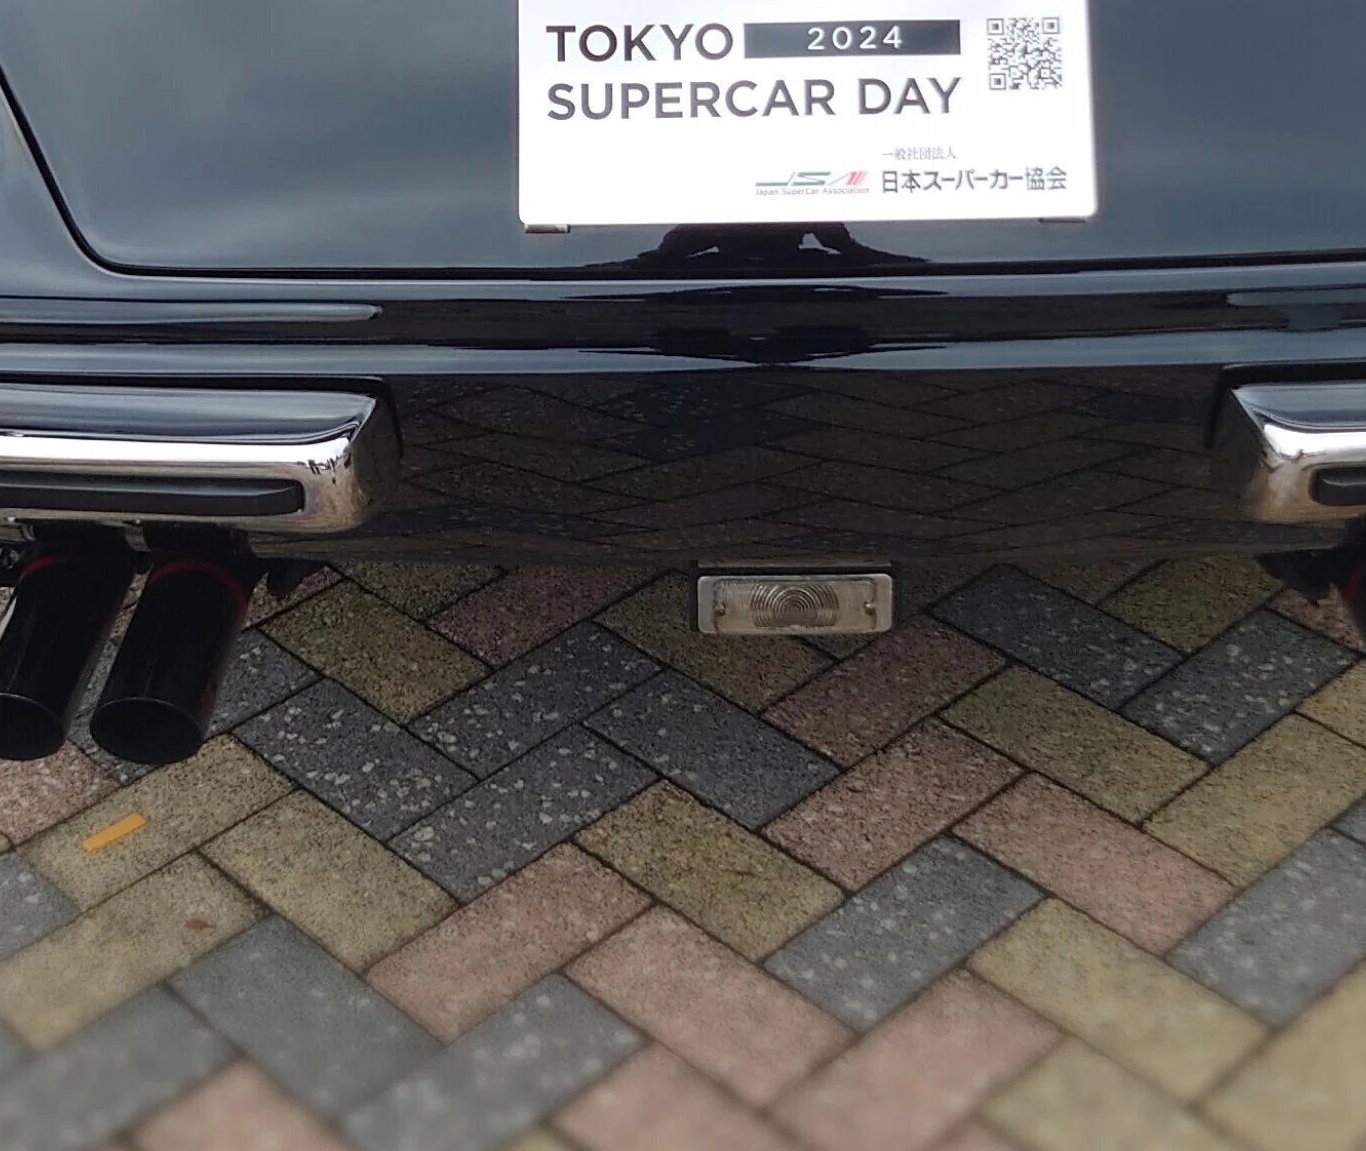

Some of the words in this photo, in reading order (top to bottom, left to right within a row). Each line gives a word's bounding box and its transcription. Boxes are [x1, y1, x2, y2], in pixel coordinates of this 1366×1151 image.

[546, 23, 734, 62] TOKYO
[807, 26, 903, 50] 2024
[547, 78, 836, 121] SUPERCAR
[858, 76, 961, 115] DAY
[755, 188, 779, 196] Japan
[821, 185, 870, 195] Association
[882, 165, 1067, 194] 日本スーパーカー協会
